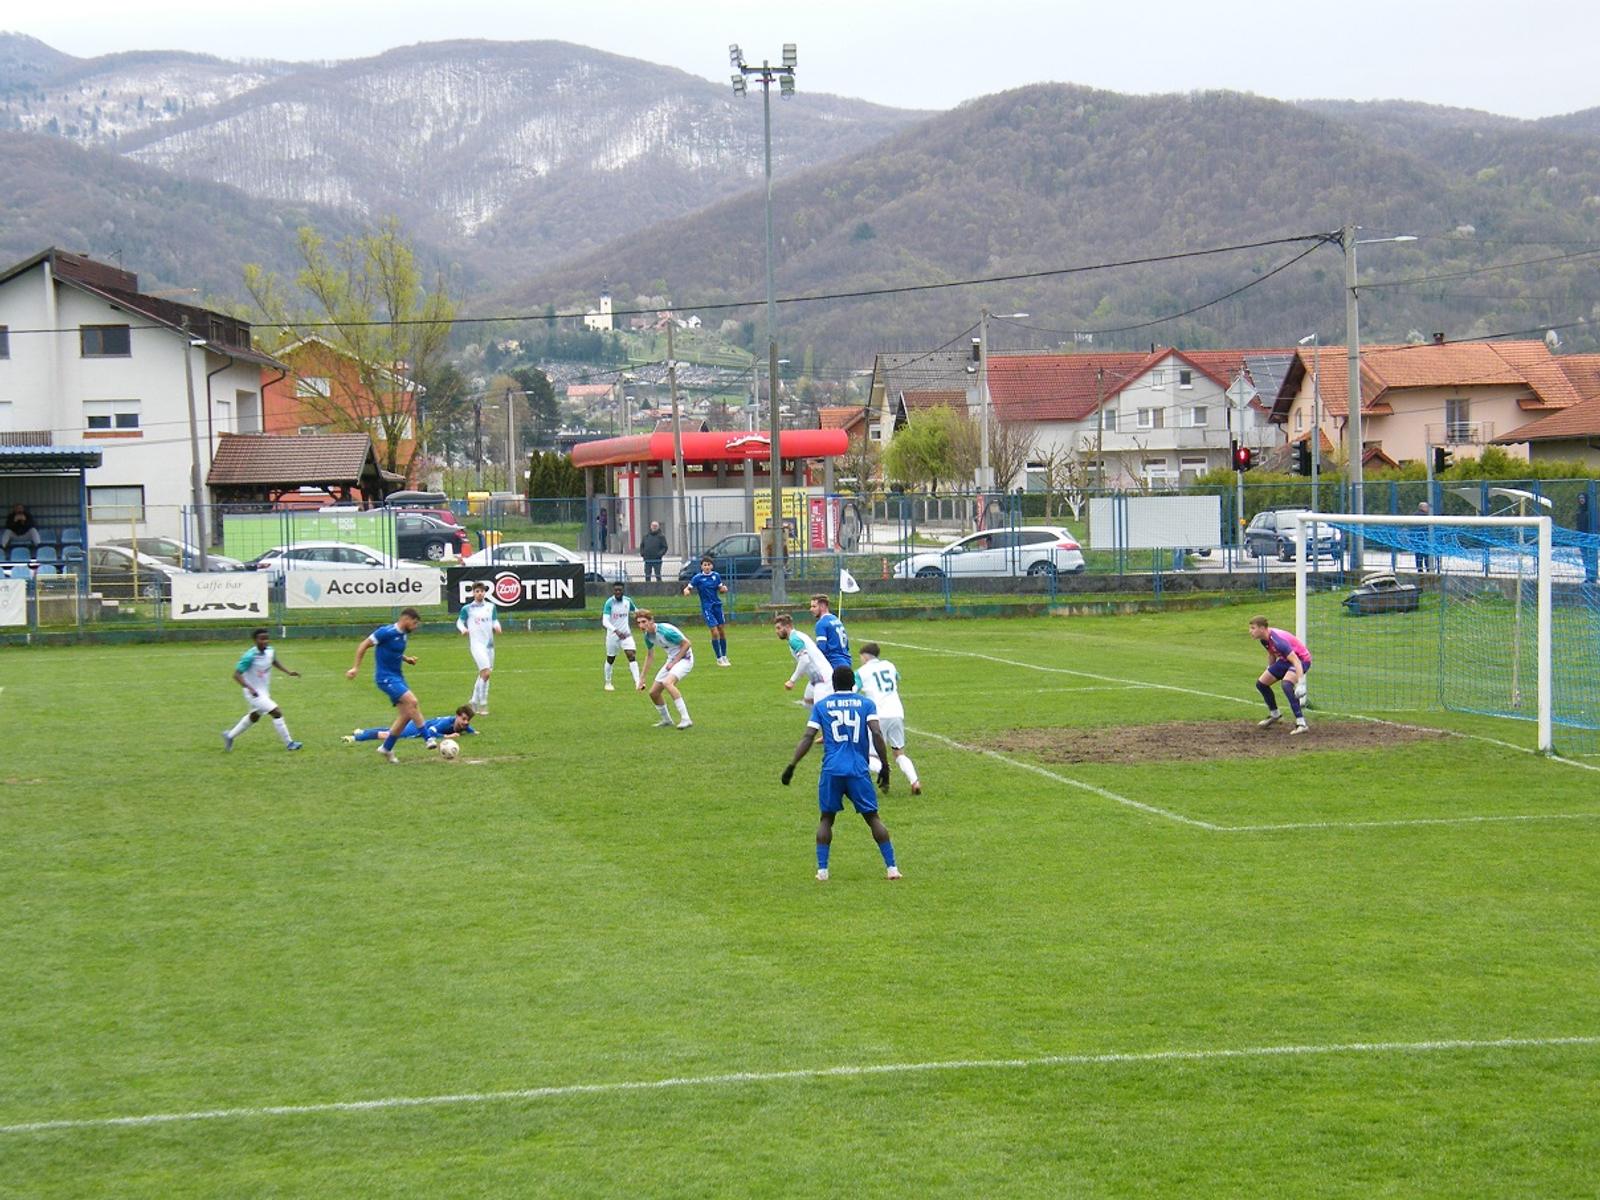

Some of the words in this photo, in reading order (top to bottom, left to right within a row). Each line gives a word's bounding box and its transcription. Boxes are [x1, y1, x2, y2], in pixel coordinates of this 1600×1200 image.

[225, 580, 243, 590] bar
[327, 578, 423, 595] Accolade
[872, 670, 894, 692] 15
[837, 699, 862, 708] BISTRA
[828, 709, 861, 743] 24
